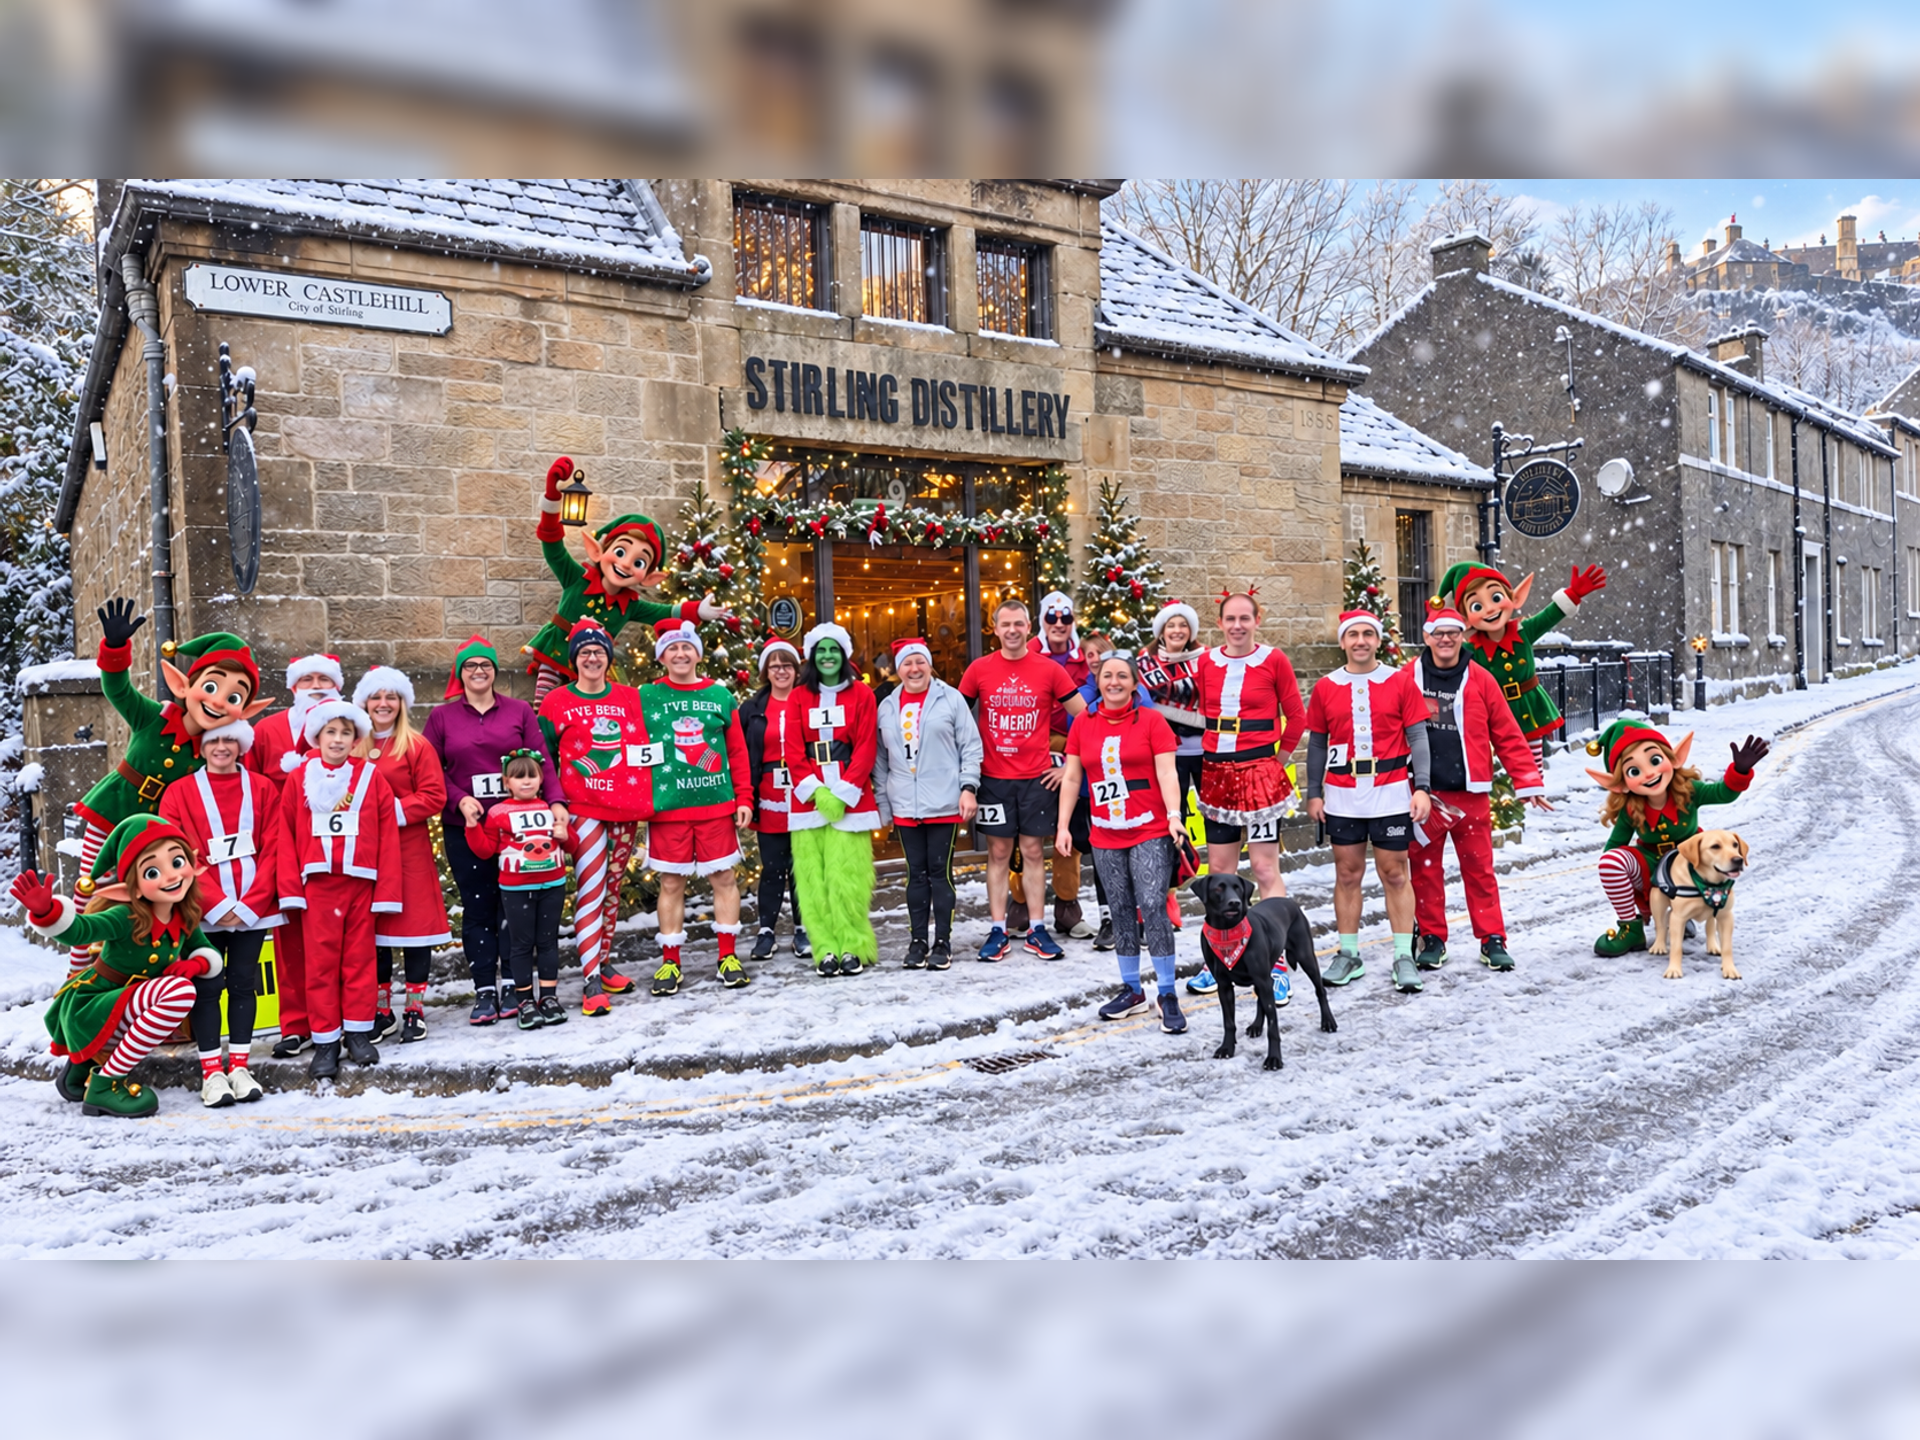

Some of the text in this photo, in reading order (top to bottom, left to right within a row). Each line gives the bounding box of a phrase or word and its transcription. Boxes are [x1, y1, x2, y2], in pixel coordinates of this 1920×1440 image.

[210, 273, 430, 315] LOWER CASTLEHILL
[288, 301, 364, 319] City of Stirling
[745, 356, 1070, 439] STIRLING DISTILLERY
[888, 479, 906, 512] 9
[595, 704, 626, 718] BEEN
[692, 701, 722, 713] BEEN
[821, 709, 833, 726] 1
[1000, 709, 1040, 731] MERRY
[641, 747, 653, 764] 5
[904, 743, 918, 760] 1
[482, 777, 508, 795] 11
[585, 777, 614, 792] NICE
[1097, 781, 1121, 803] 22
[328, 813, 343, 833] 6
[519, 812, 547, 829] 10
[979, 807, 1000, 823] 12
[1250, 822, 1274, 840] 21
[223, 836, 238, 857] 7
